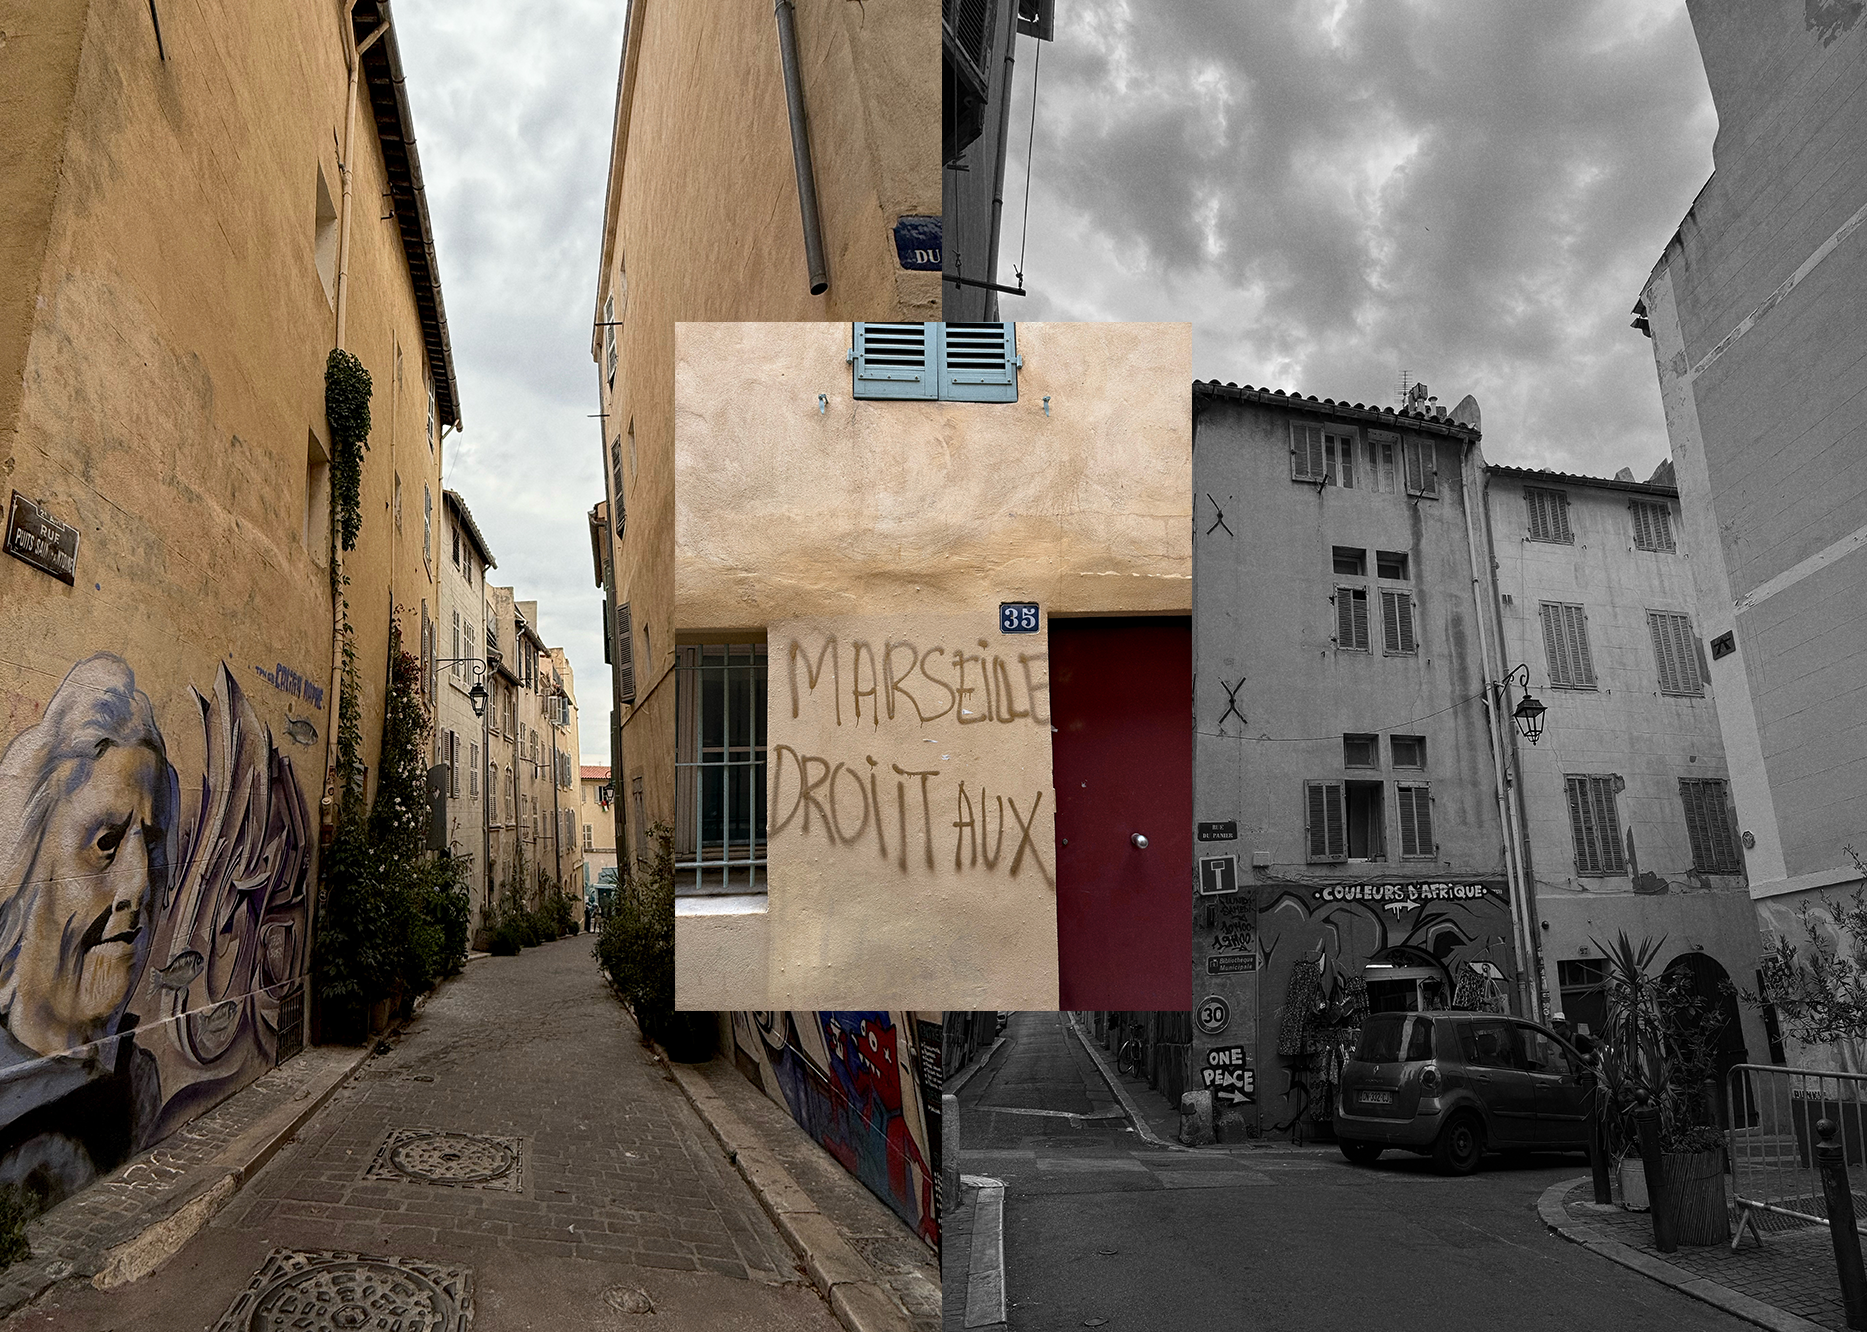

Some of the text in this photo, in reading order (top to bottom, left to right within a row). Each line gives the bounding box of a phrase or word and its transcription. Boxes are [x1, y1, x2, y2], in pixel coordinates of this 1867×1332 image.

[914, 249, 941, 264] DU
[15, 528, 35, 551] PUITS
[40, 524, 61, 545] RUE
[1003, 607, 1037, 630] 35
[952, 780, 1056, 892] AUX
[1322, 884, 1405, 900] COULEURS
[1407, 882, 1483, 900] D'AFRIQUE
[1203, 1006, 1224, 1024] 30
[1209, 1048, 1243, 1066] ONE
[1203, 1068, 1254, 1093] PEACE
